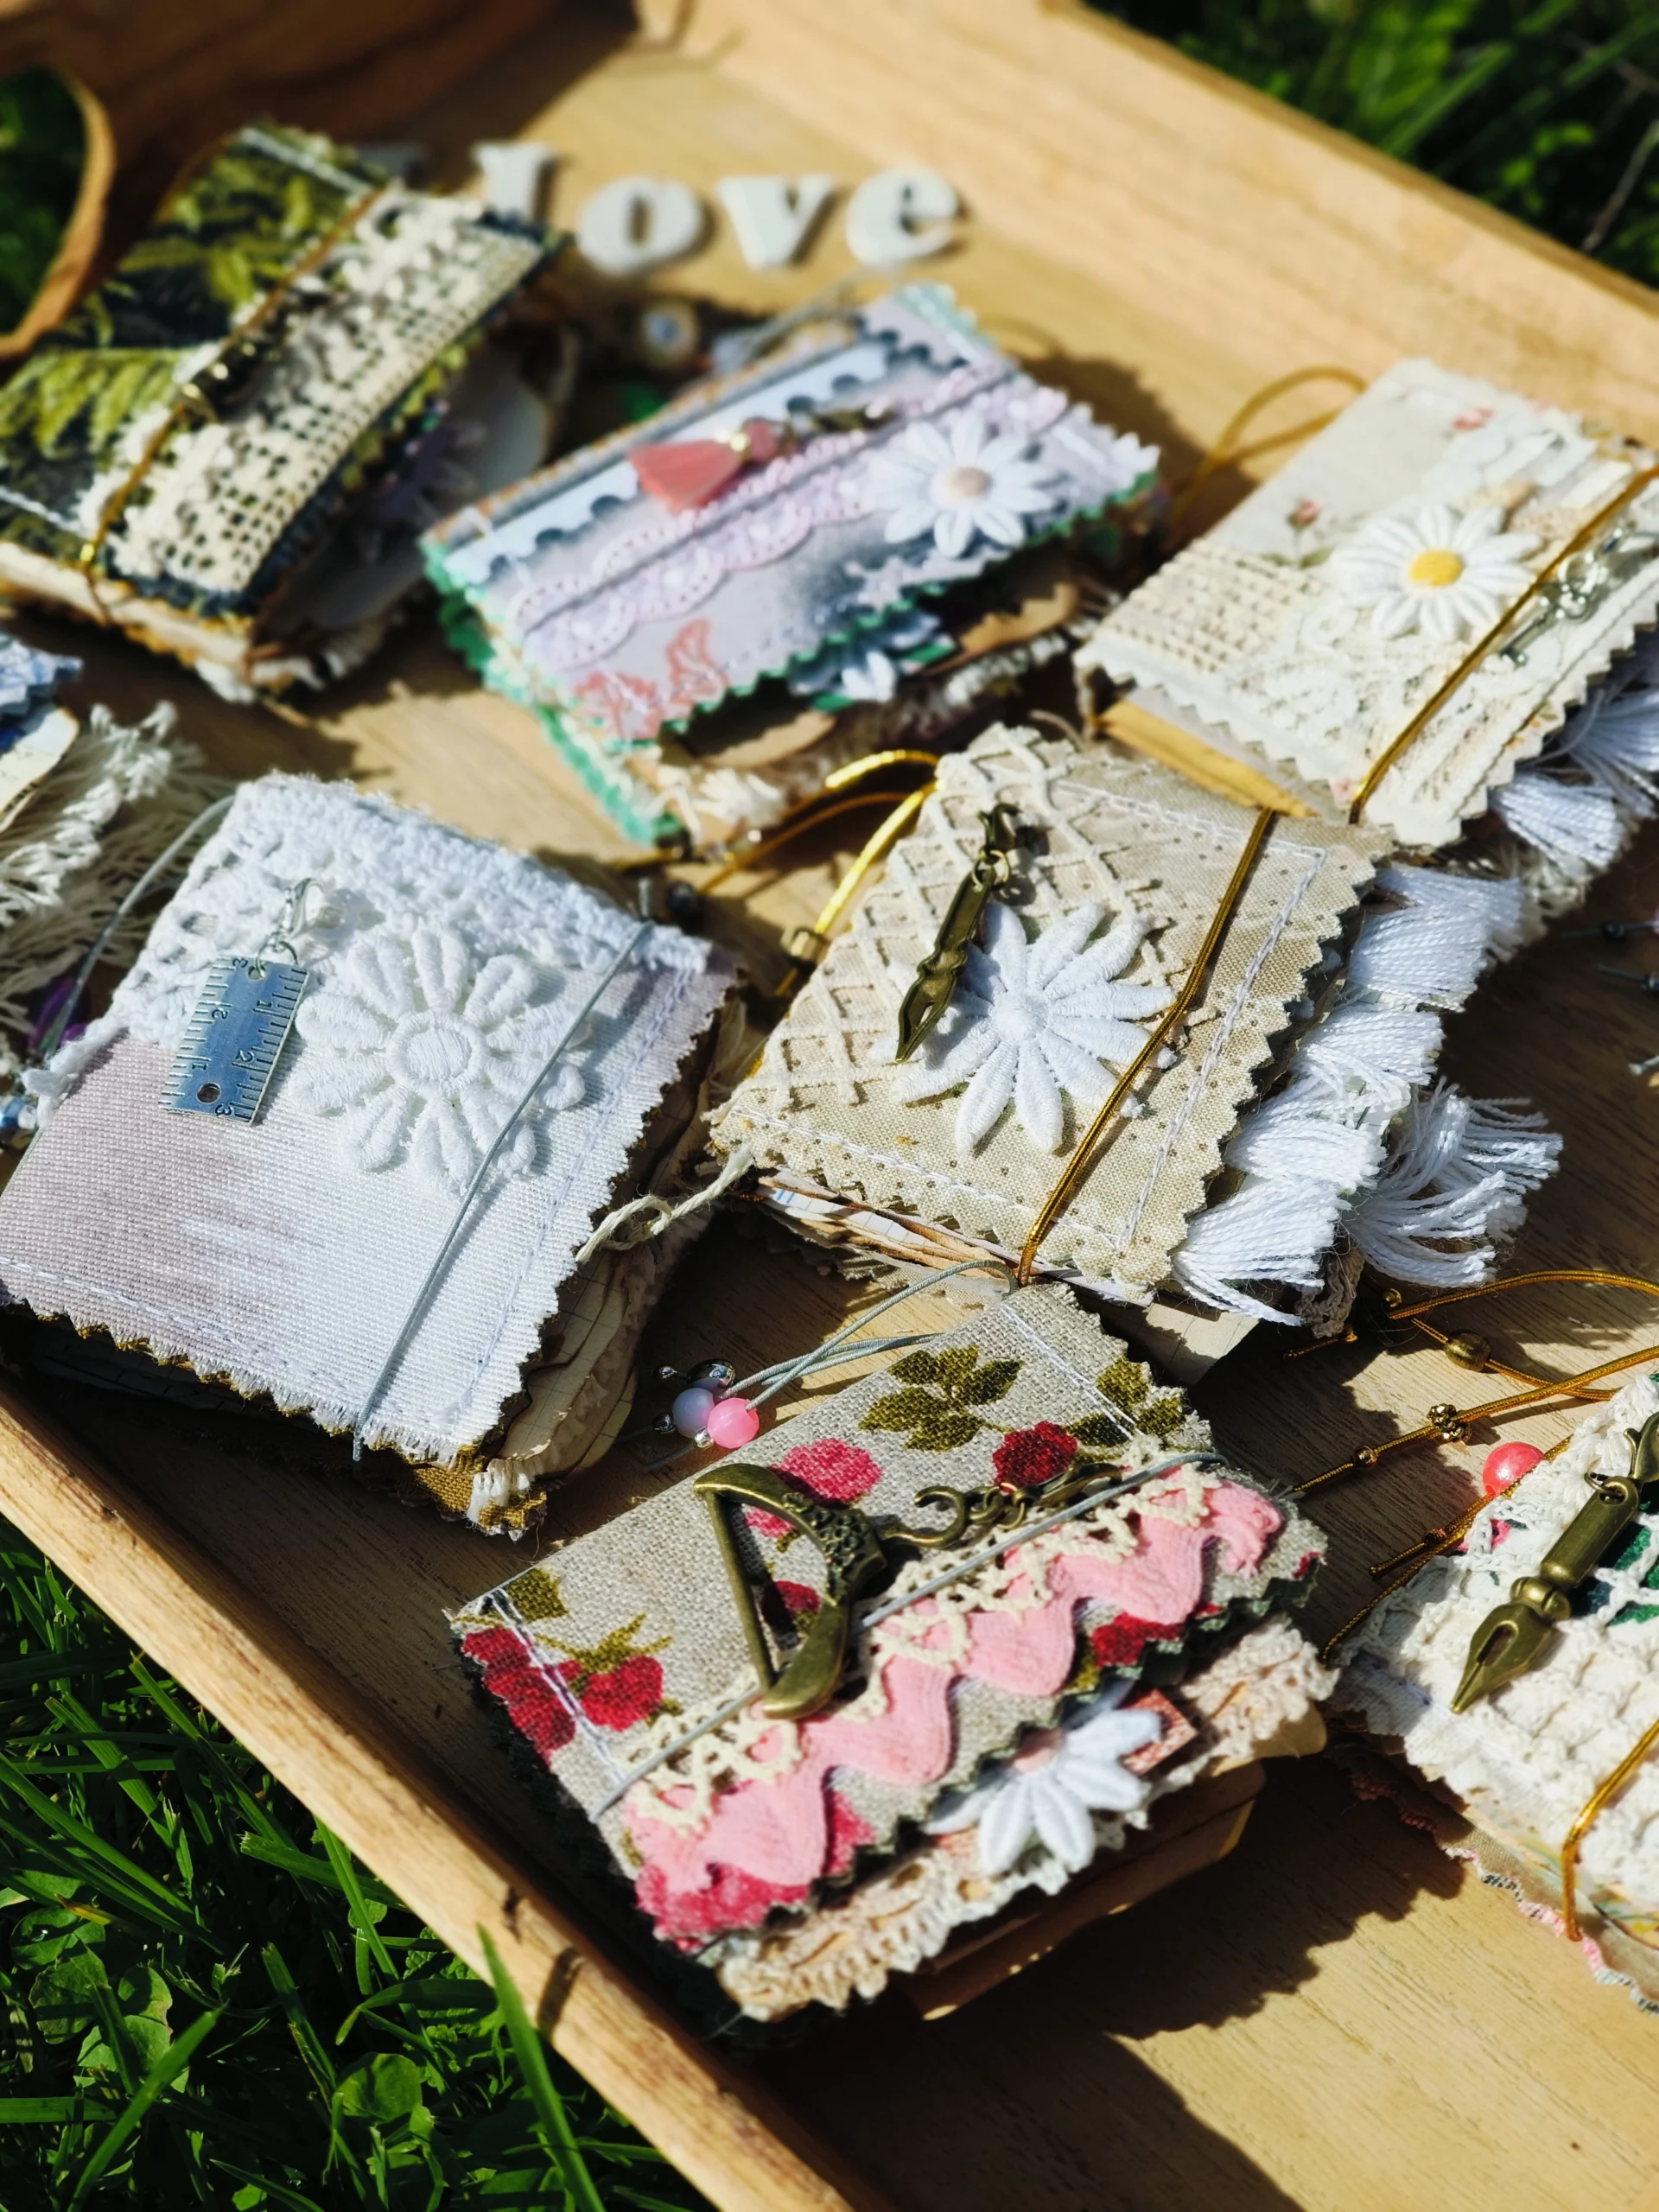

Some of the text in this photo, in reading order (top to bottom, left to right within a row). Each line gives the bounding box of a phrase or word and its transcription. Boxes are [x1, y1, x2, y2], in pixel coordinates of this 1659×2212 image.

[192, 957, 248, 1071] 1 2 3
[235, 1049, 254, 1063] 2
[215, 1103, 232, 1117] 3
